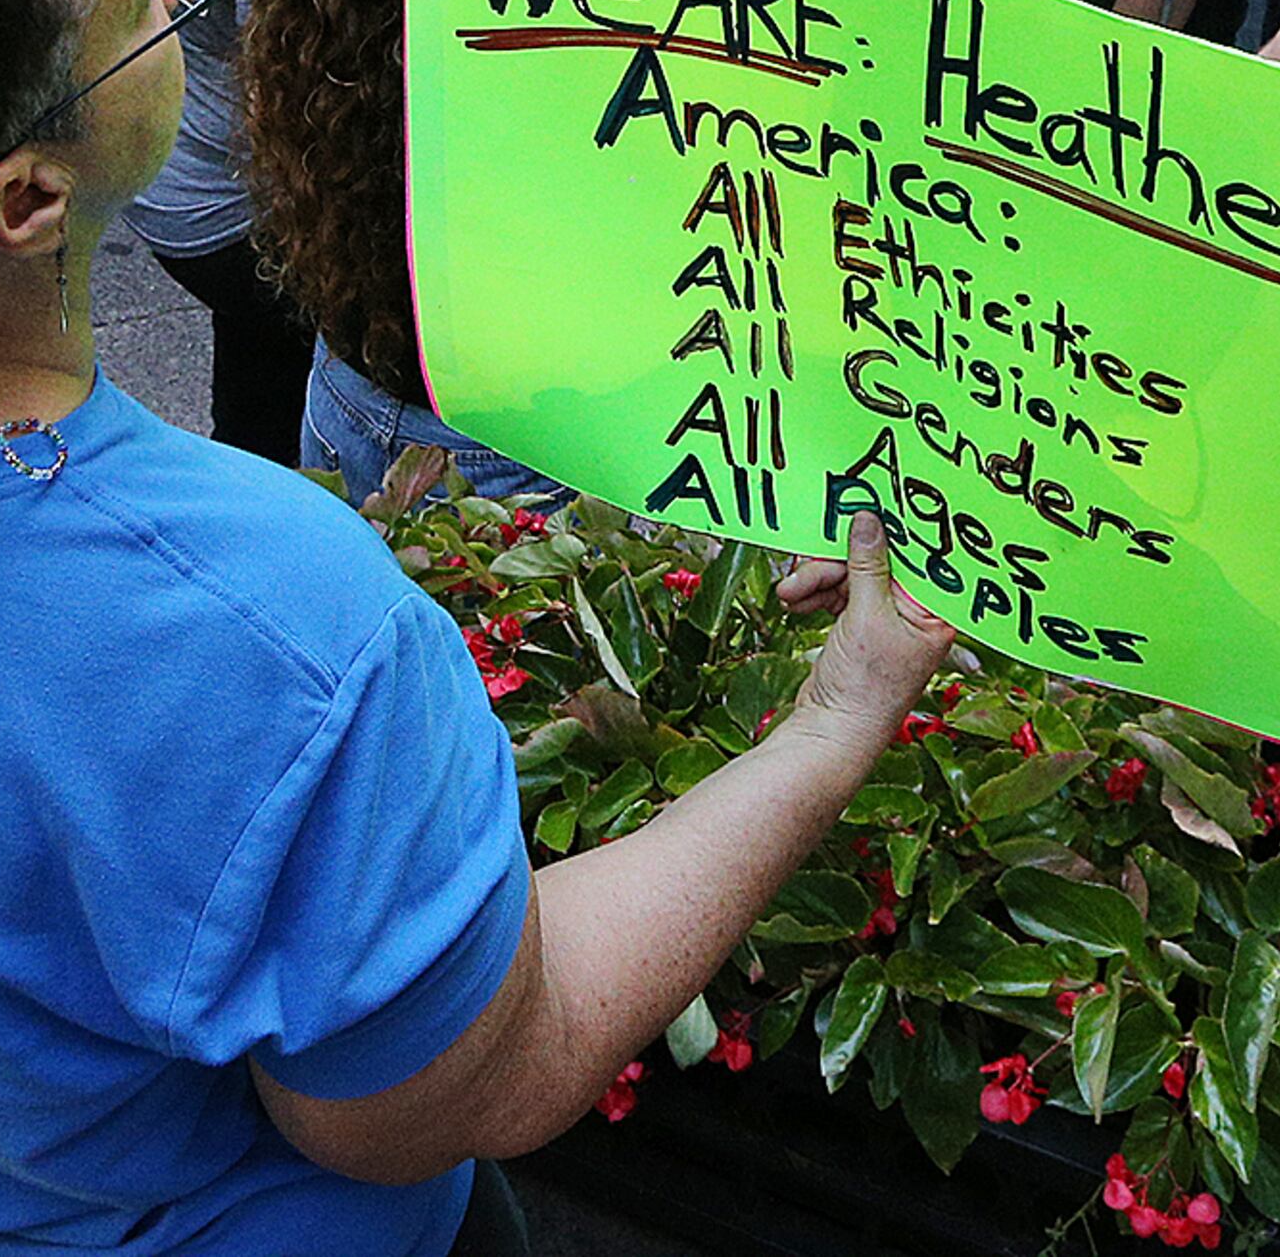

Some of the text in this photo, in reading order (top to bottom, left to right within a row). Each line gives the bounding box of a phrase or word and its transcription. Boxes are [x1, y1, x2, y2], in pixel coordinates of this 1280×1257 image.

[593, 44, 1021, 252] America:
[682, 162, 783, 260] All
[669, 308, 1175, 565] All Genders
[672, 245, 1149, 466] All Religions
[644, 453, 1148, 664] All Peoples
[665, 383, 1050, 591] All Ages
